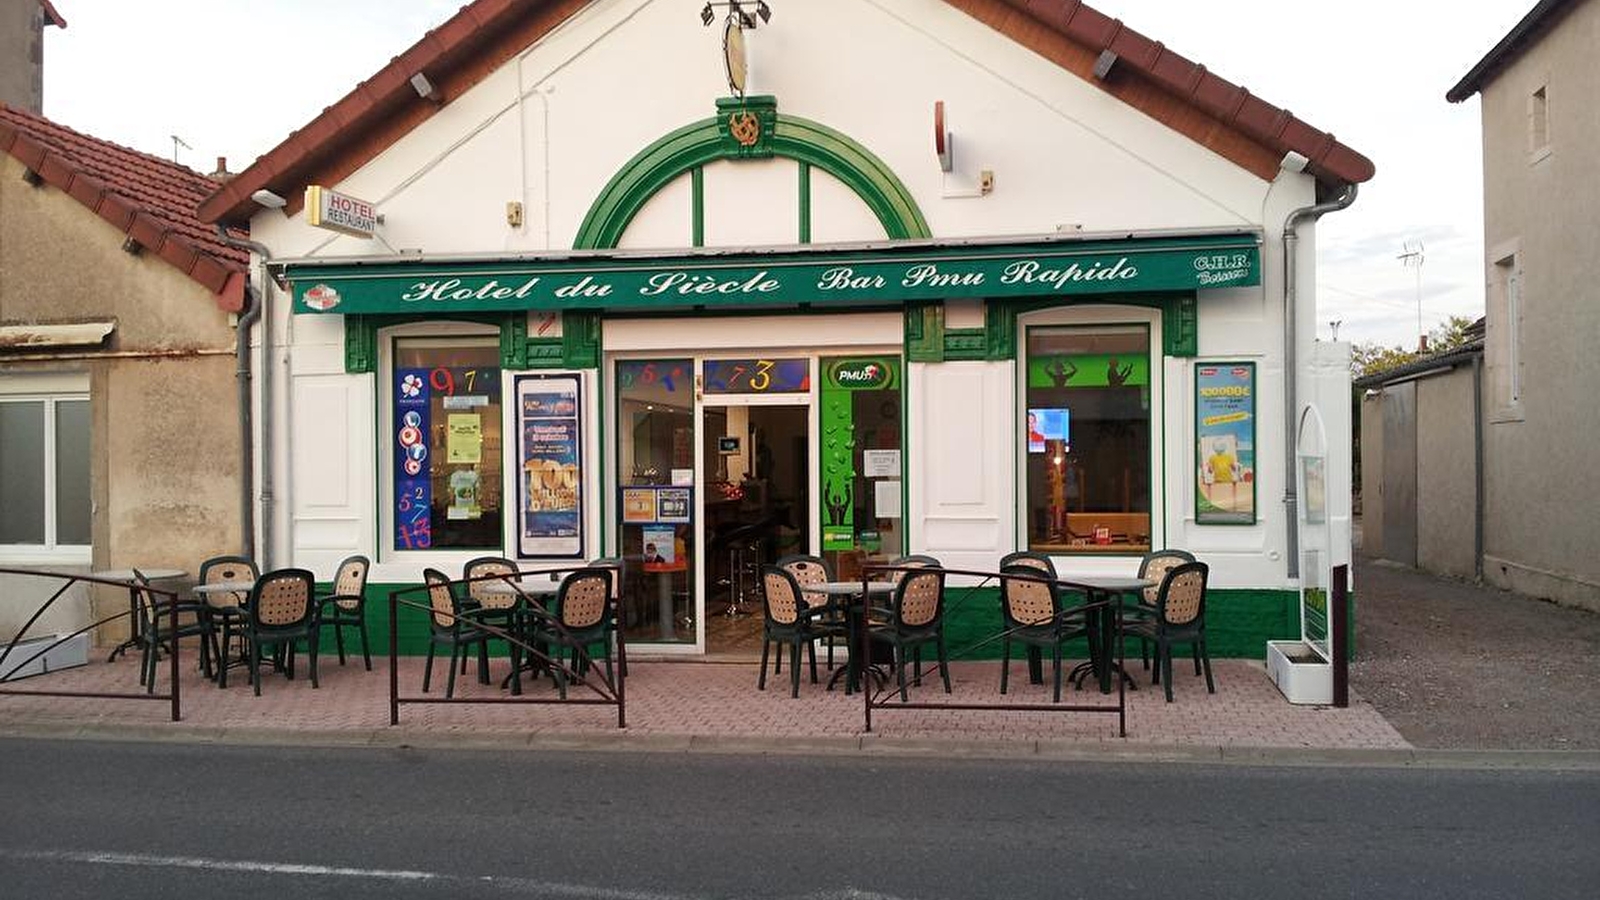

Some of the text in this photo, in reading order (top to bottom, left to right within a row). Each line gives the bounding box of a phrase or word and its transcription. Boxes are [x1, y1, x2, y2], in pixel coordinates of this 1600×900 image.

[328, 208, 375, 231] RESTAURANT
[331, 195, 375, 220] HOTEL
[402, 257, 1139, 302] Hotel du Siècle Bar Pmu Rapido
[839, 371, 865, 380] PMU
